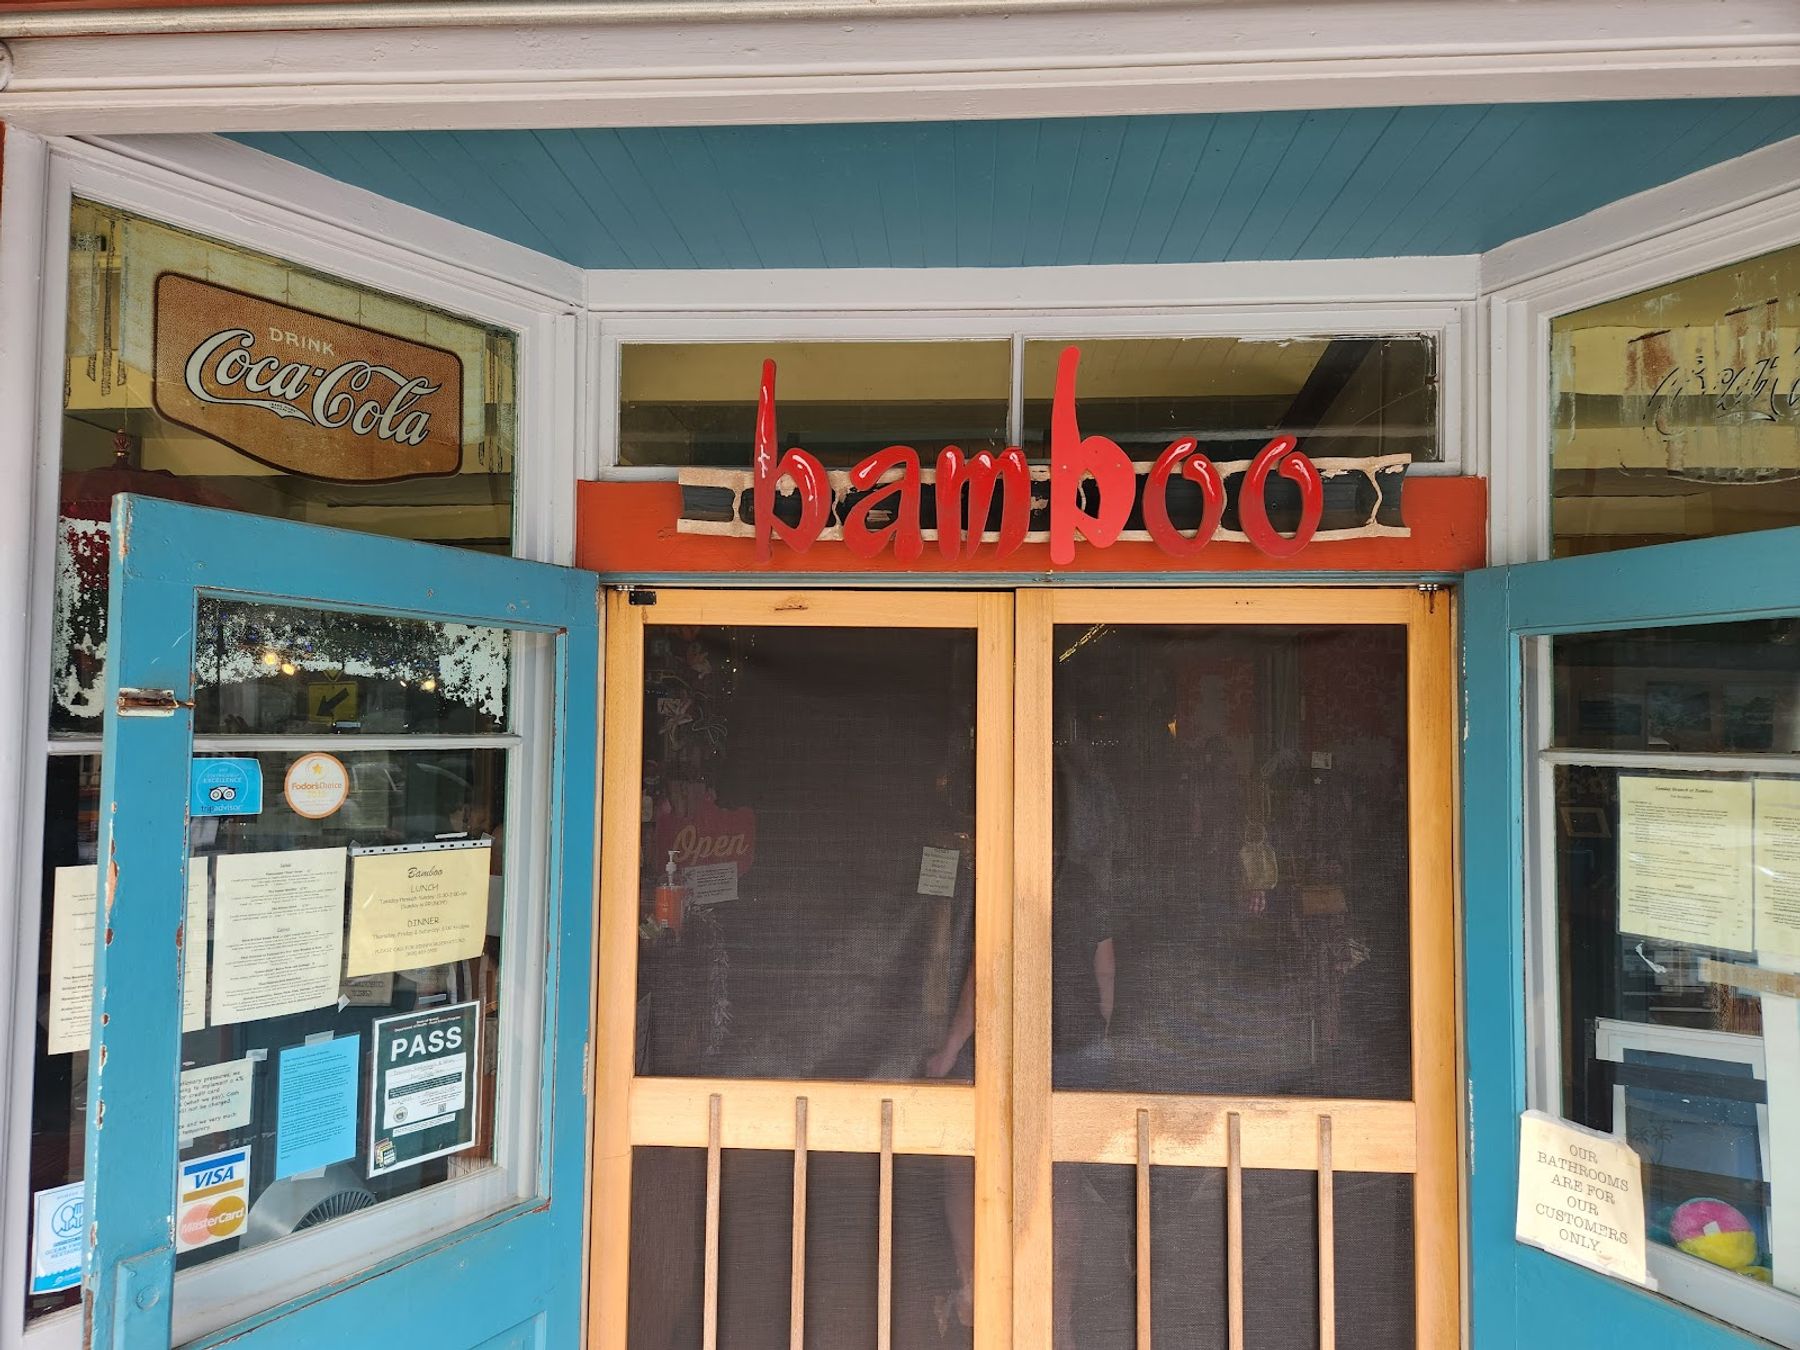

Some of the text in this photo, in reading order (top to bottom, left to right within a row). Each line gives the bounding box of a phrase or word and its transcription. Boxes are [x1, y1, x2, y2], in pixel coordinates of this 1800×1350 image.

[268, 327, 335, 356] DRINK
[184, 328, 442, 446] Coca-Cola
[753, 345, 1324, 565] bamboo
[201, 803, 242, 814] tripadvisor
[674, 824, 750, 866] Open
[407, 866, 444, 879] Bamboo
[410, 883, 439, 894] LUNCH
[407, 916, 440, 928] DINNER
[390, 1026, 463, 1062] PASS
[1569, 1144, 1598, 1164] OUR
[194, 1165, 235, 1189] VISA
[1537, 1151, 1630, 1192] BATHROOMS
[1551, 1174, 1616, 1205] ARE FOR
[1566, 1196, 1599, 1216] OUR
[182, 1207, 245, 1233] MasterCard
[1535, 1203, 1629, 1245] CUSTOMERS
[1559, 1228, 1602, 1254] ONLY.
